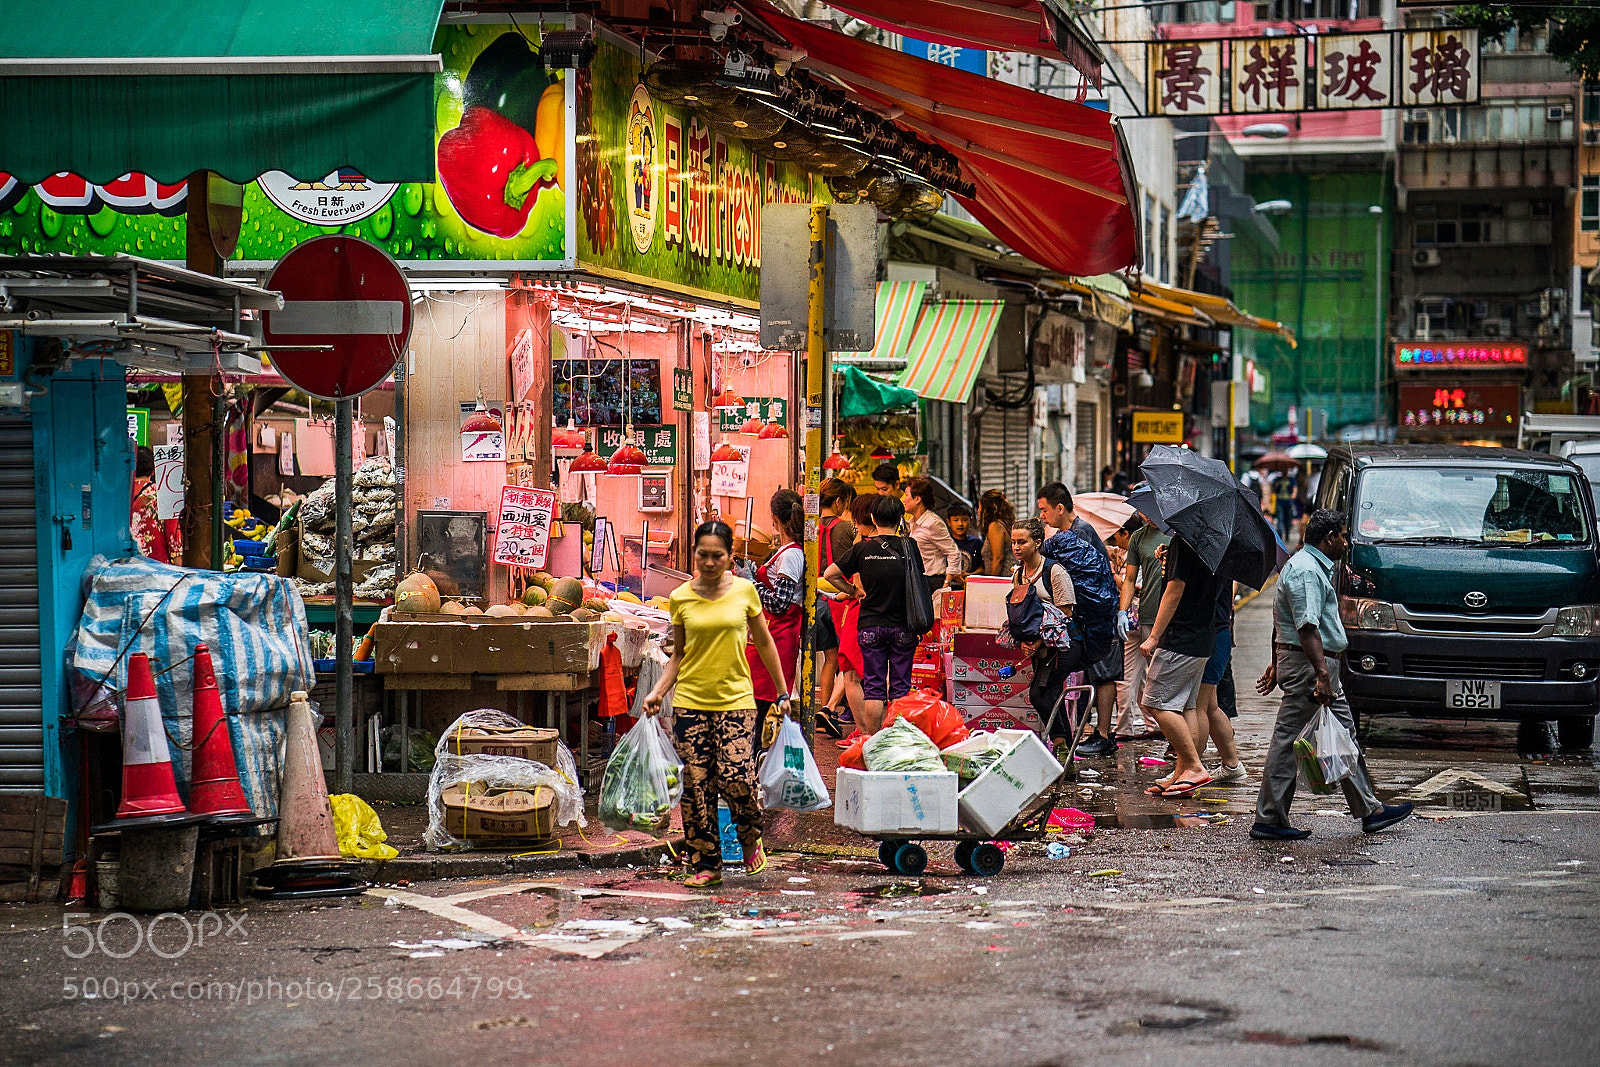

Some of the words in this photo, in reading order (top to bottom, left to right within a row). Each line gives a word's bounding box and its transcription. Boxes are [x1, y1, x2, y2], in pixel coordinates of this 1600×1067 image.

[292, 200, 319, 216] Fresh
[321, 200, 365, 217] Everyday
[317, 196, 344, 207] 日新
[715, 134, 762, 268] Fresh
[1461, 680, 1486, 695] NW
[1452, 693, 1495, 708] 6621
